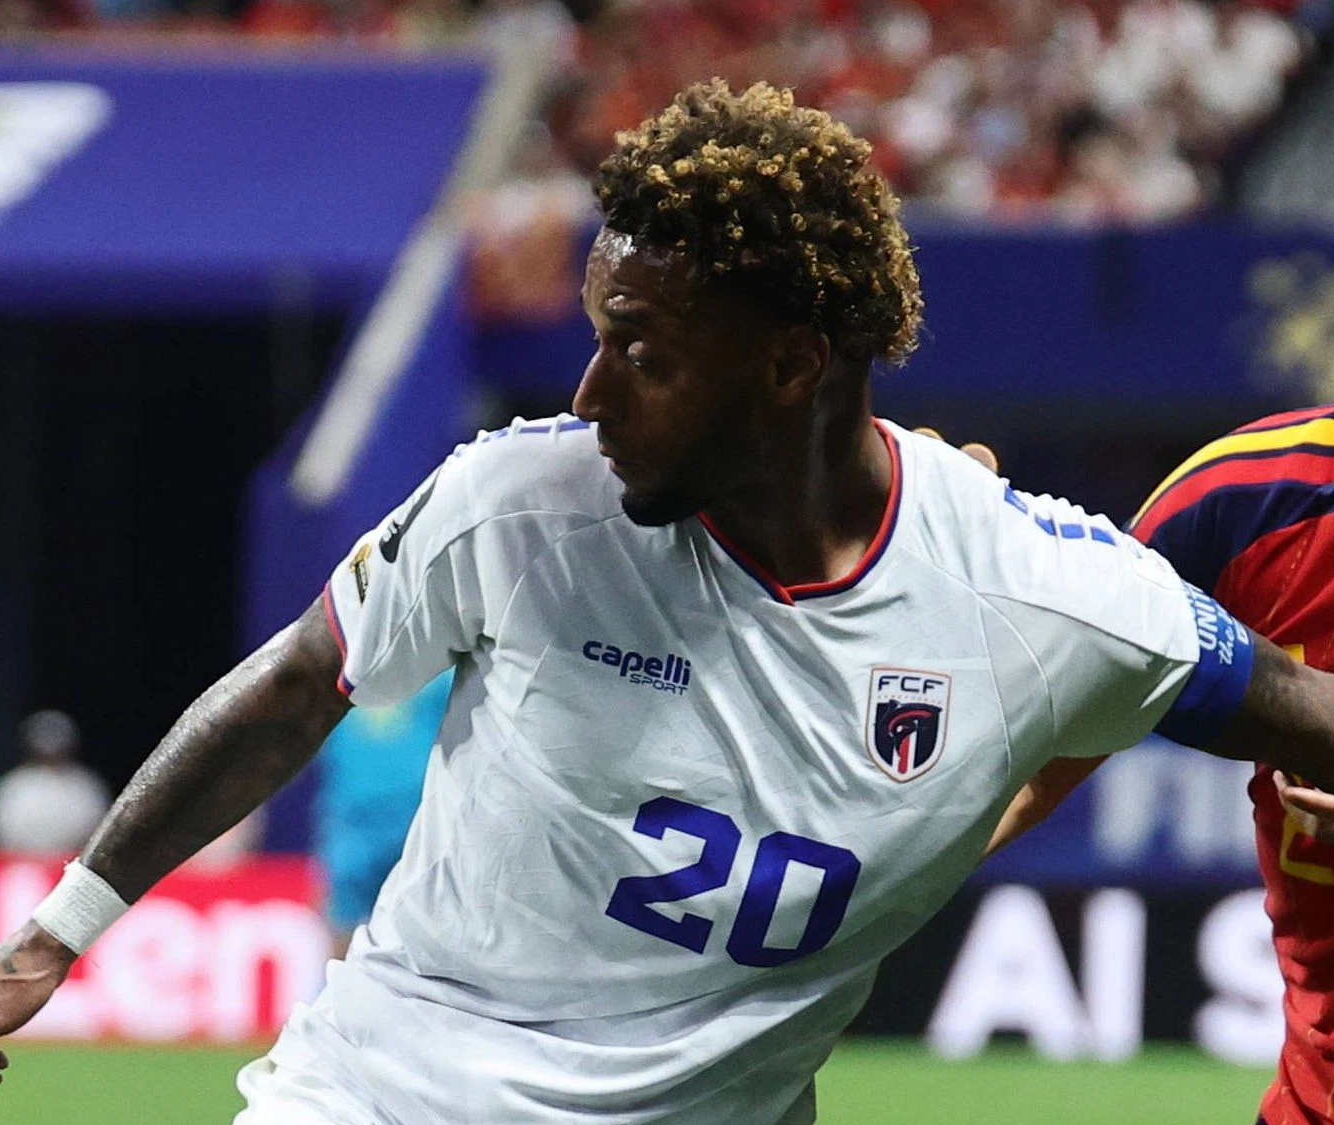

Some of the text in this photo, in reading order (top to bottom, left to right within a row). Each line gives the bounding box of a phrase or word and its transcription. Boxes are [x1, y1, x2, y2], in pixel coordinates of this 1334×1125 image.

[582, 640, 692, 687] capelli
[629, 673, 689, 696] SPORT
[877, 675, 945, 695] FCF
[604, 795, 862, 968] 20
[927, 883, 1147, 1062] AI
